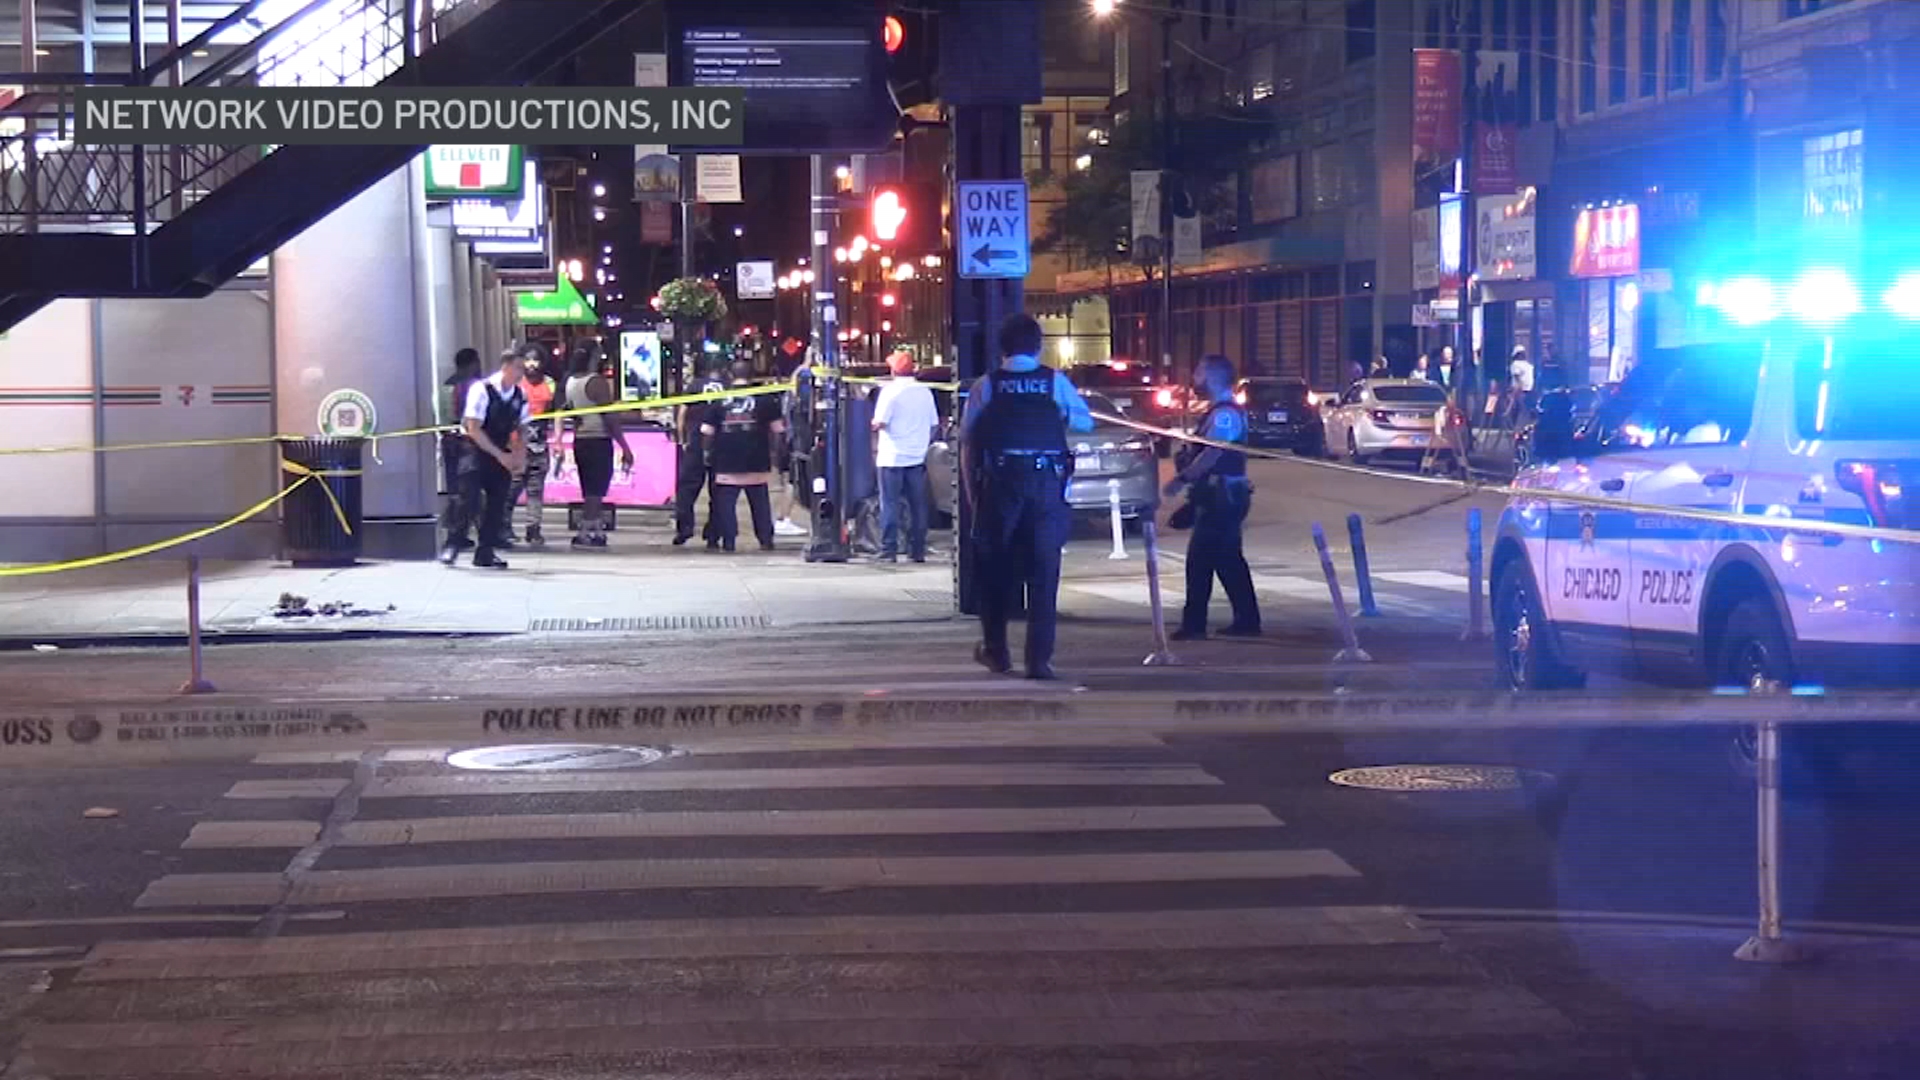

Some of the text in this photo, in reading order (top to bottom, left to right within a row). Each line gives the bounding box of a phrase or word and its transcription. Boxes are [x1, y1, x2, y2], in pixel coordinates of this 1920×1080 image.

[967, 190, 1018, 212] ONE
[966, 216, 1019, 239] WAY
[998, 378, 1048, 394] POLICE
[1563, 567, 1693, 604] CHICAGO POLICE
[482, 703, 802, 733] POLICE LINE DO NOT CROSS
